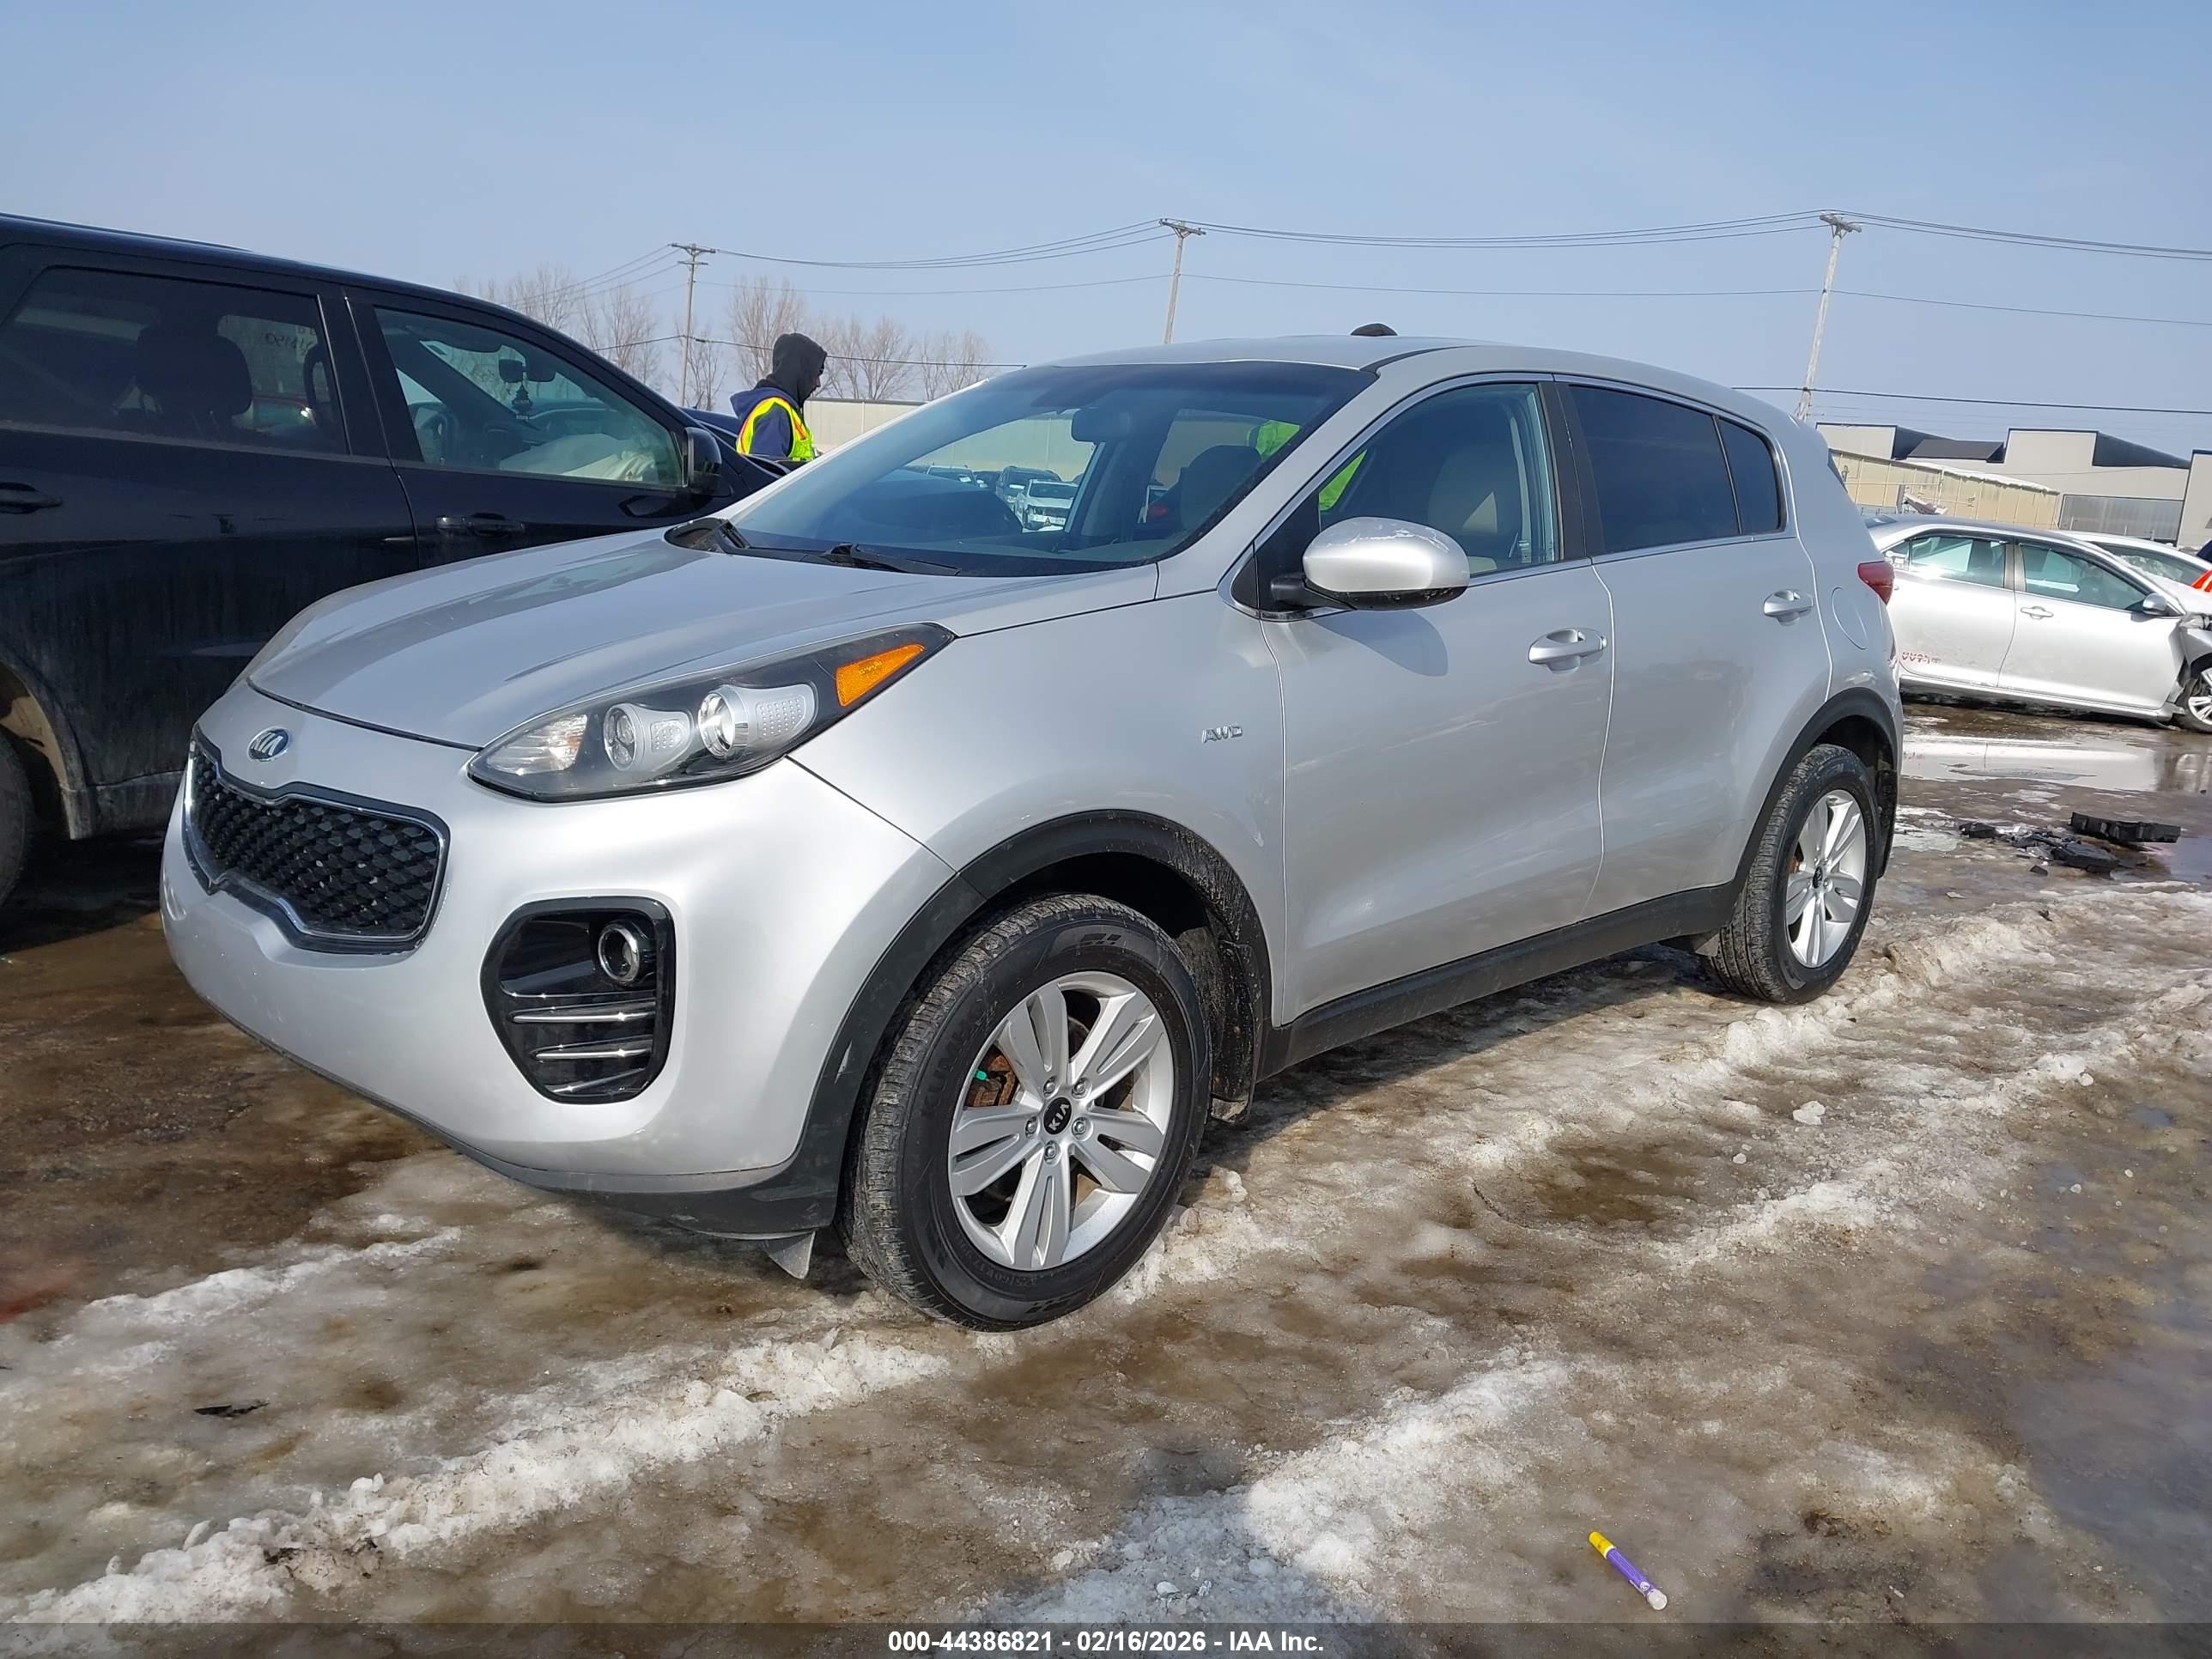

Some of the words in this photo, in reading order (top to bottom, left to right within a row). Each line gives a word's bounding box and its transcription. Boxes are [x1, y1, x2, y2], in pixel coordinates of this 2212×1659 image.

[252, 732, 283, 756] KIA
[1201, 726, 1243, 744] AWD
[1048, 1103, 1070, 1131] KIA
